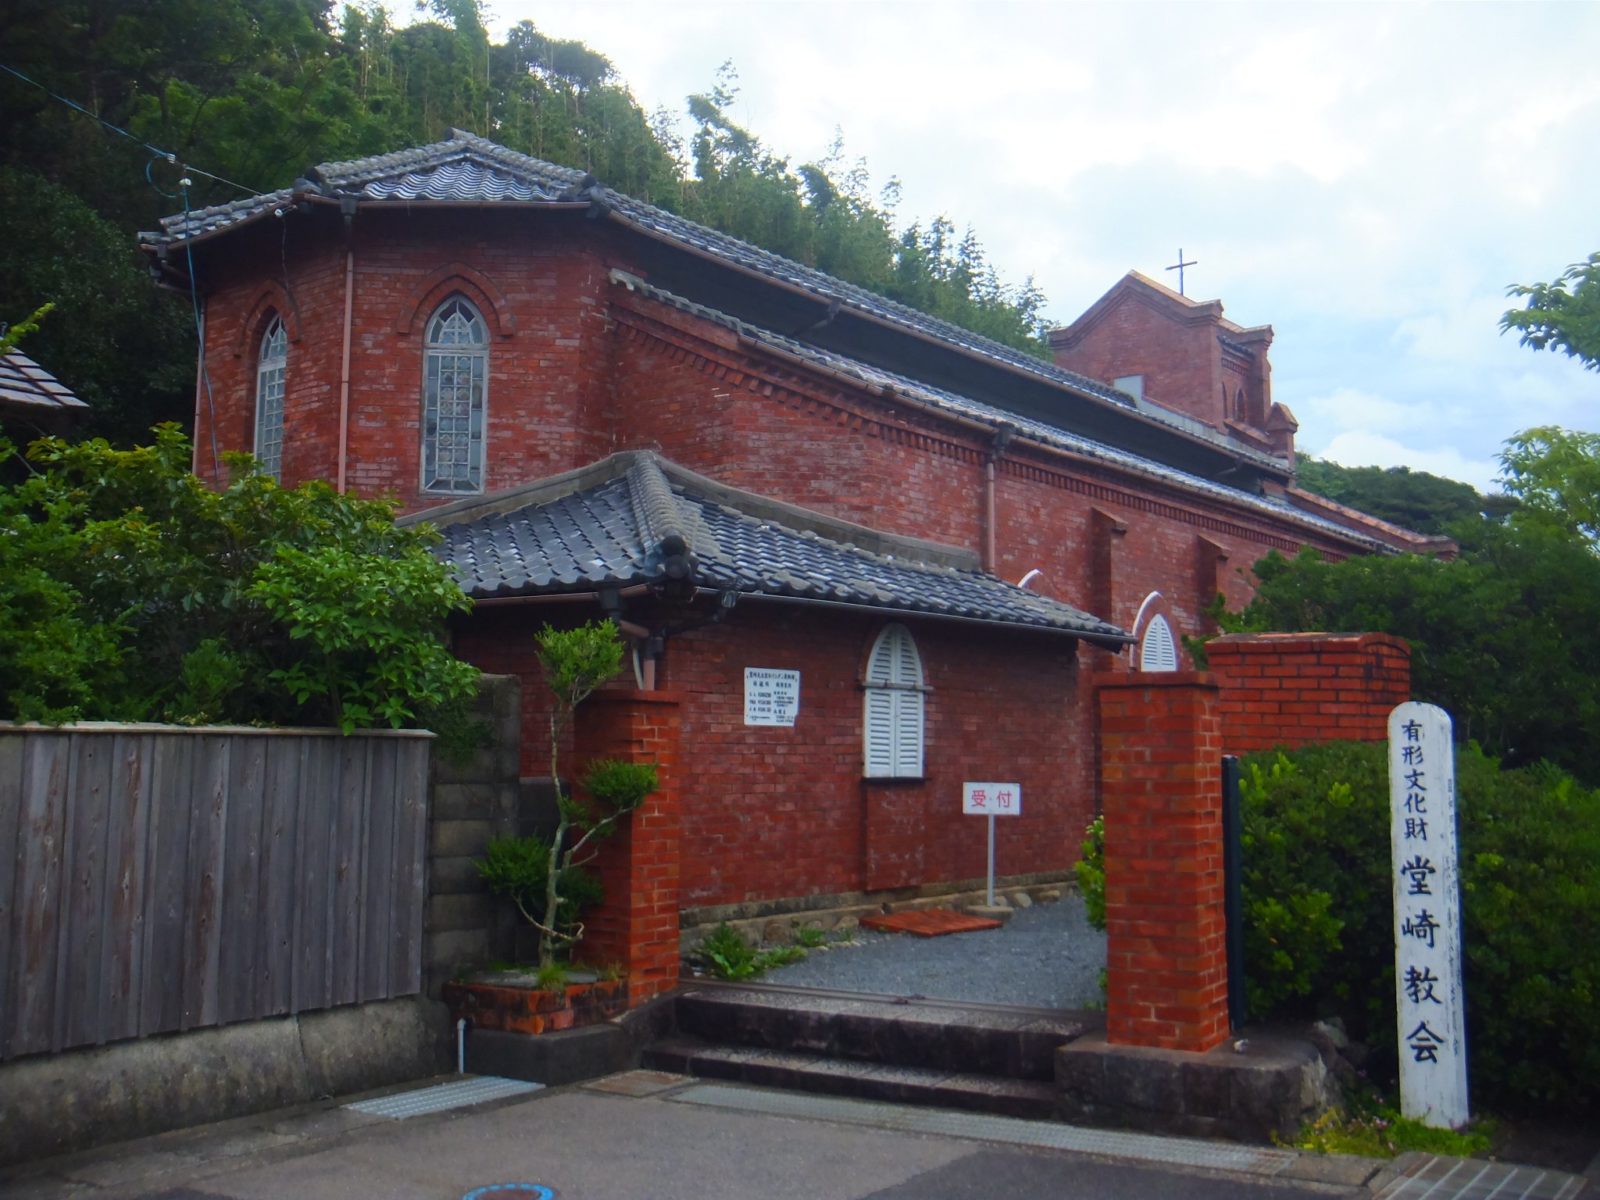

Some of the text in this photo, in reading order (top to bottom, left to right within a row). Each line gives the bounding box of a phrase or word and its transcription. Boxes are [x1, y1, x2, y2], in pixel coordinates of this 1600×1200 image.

[971, 789, 1012, 808] 受付
[1400, 718, 1444, 1064] 有形文化財 堂崎教会
